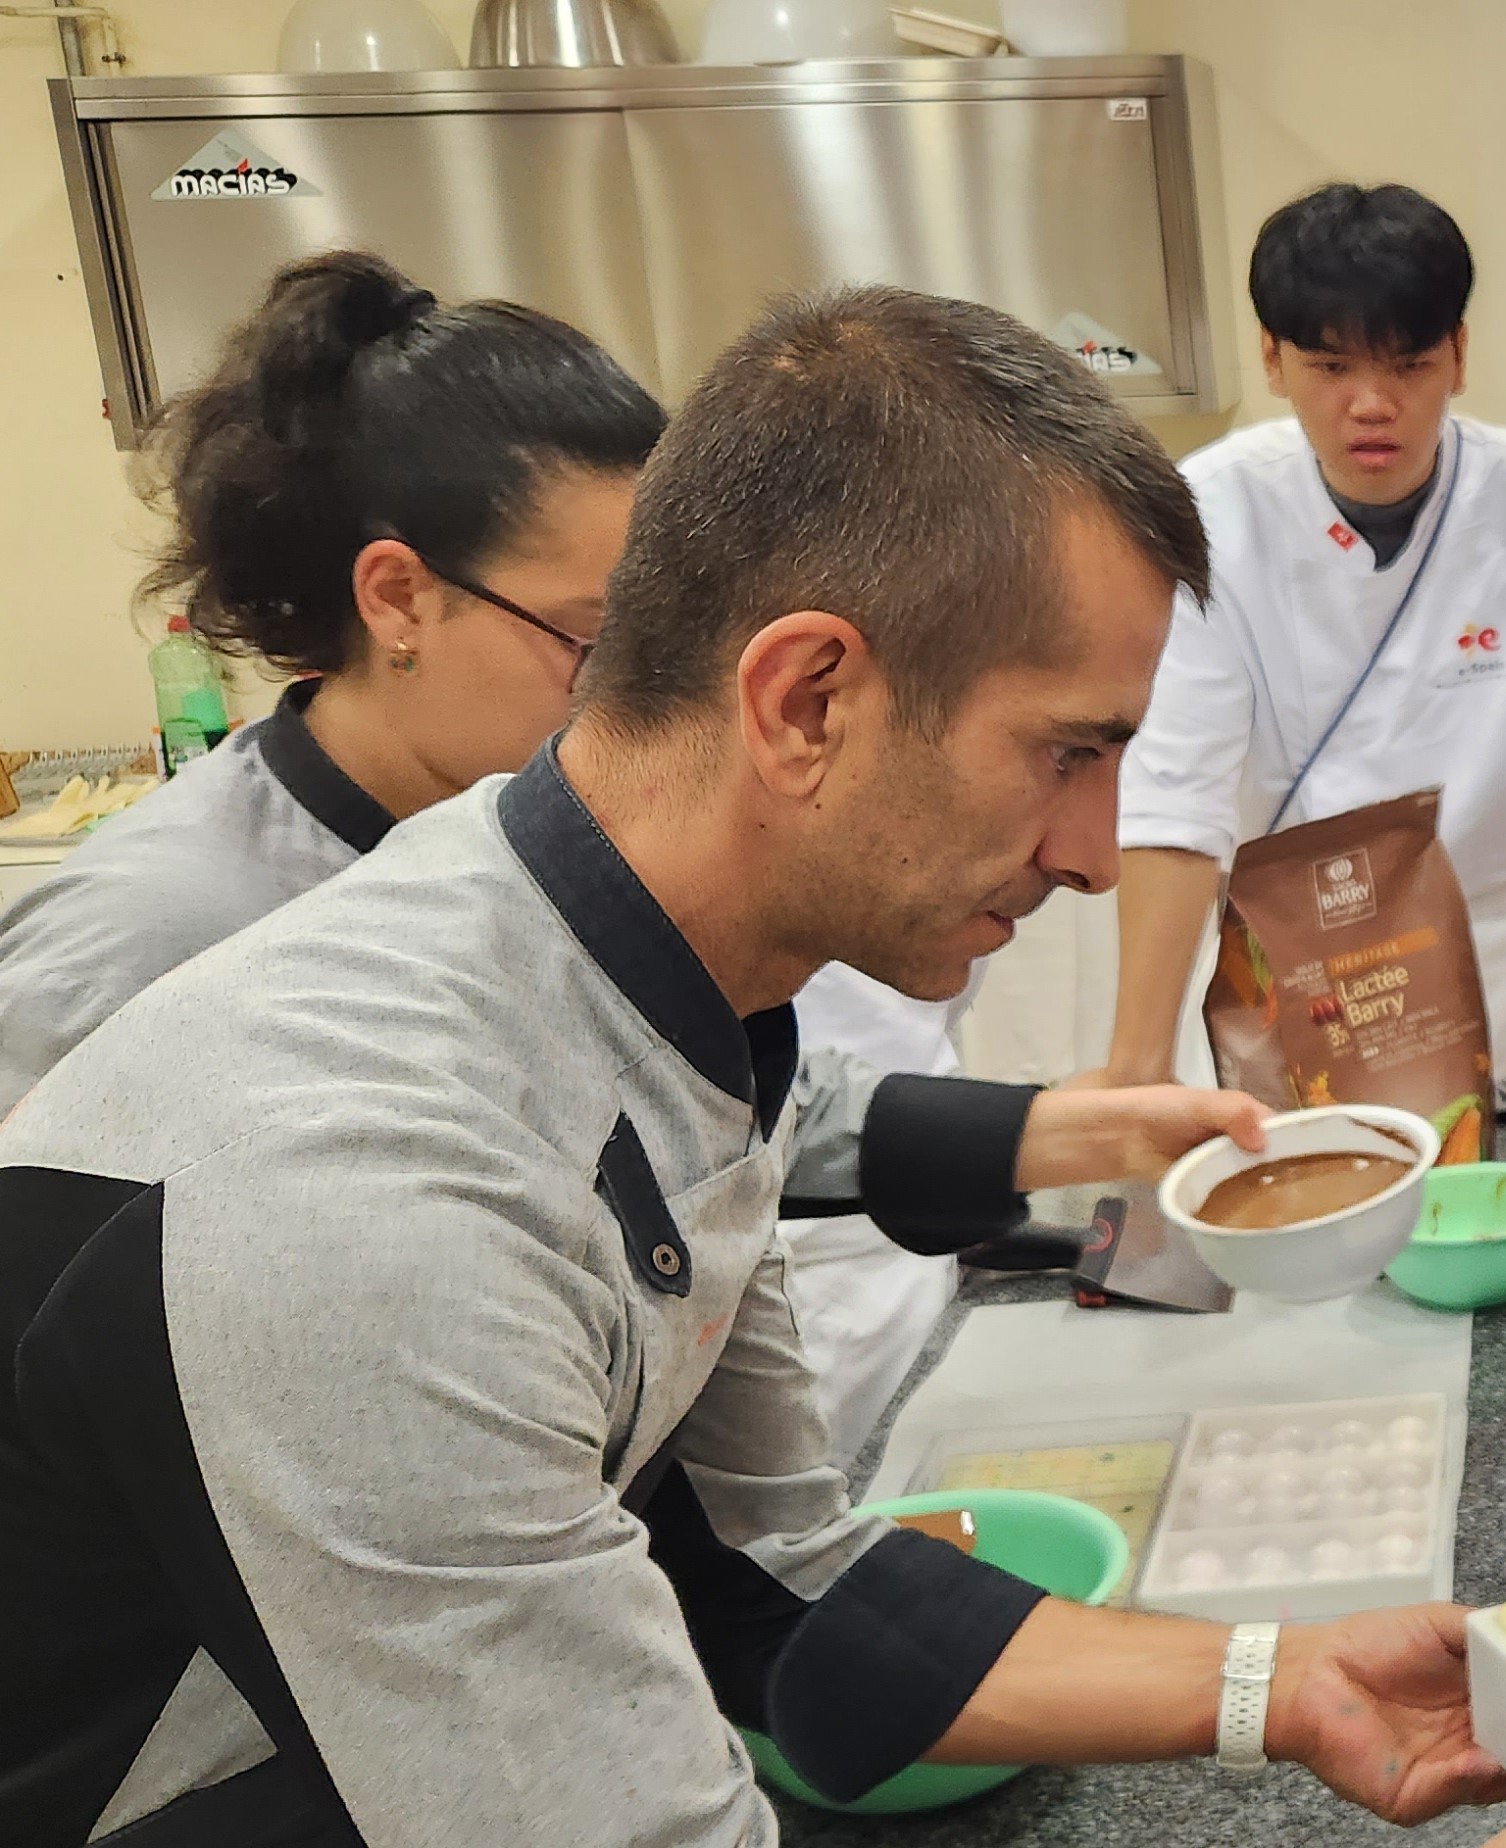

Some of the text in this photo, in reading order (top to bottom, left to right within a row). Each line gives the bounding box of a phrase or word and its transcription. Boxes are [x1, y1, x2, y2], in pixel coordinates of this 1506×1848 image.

[1321, 883, 1370, 911] BARRY
[1338, 966, 1411, 1003] Lactée
[1346, 992, 1405, 1028] Barry
